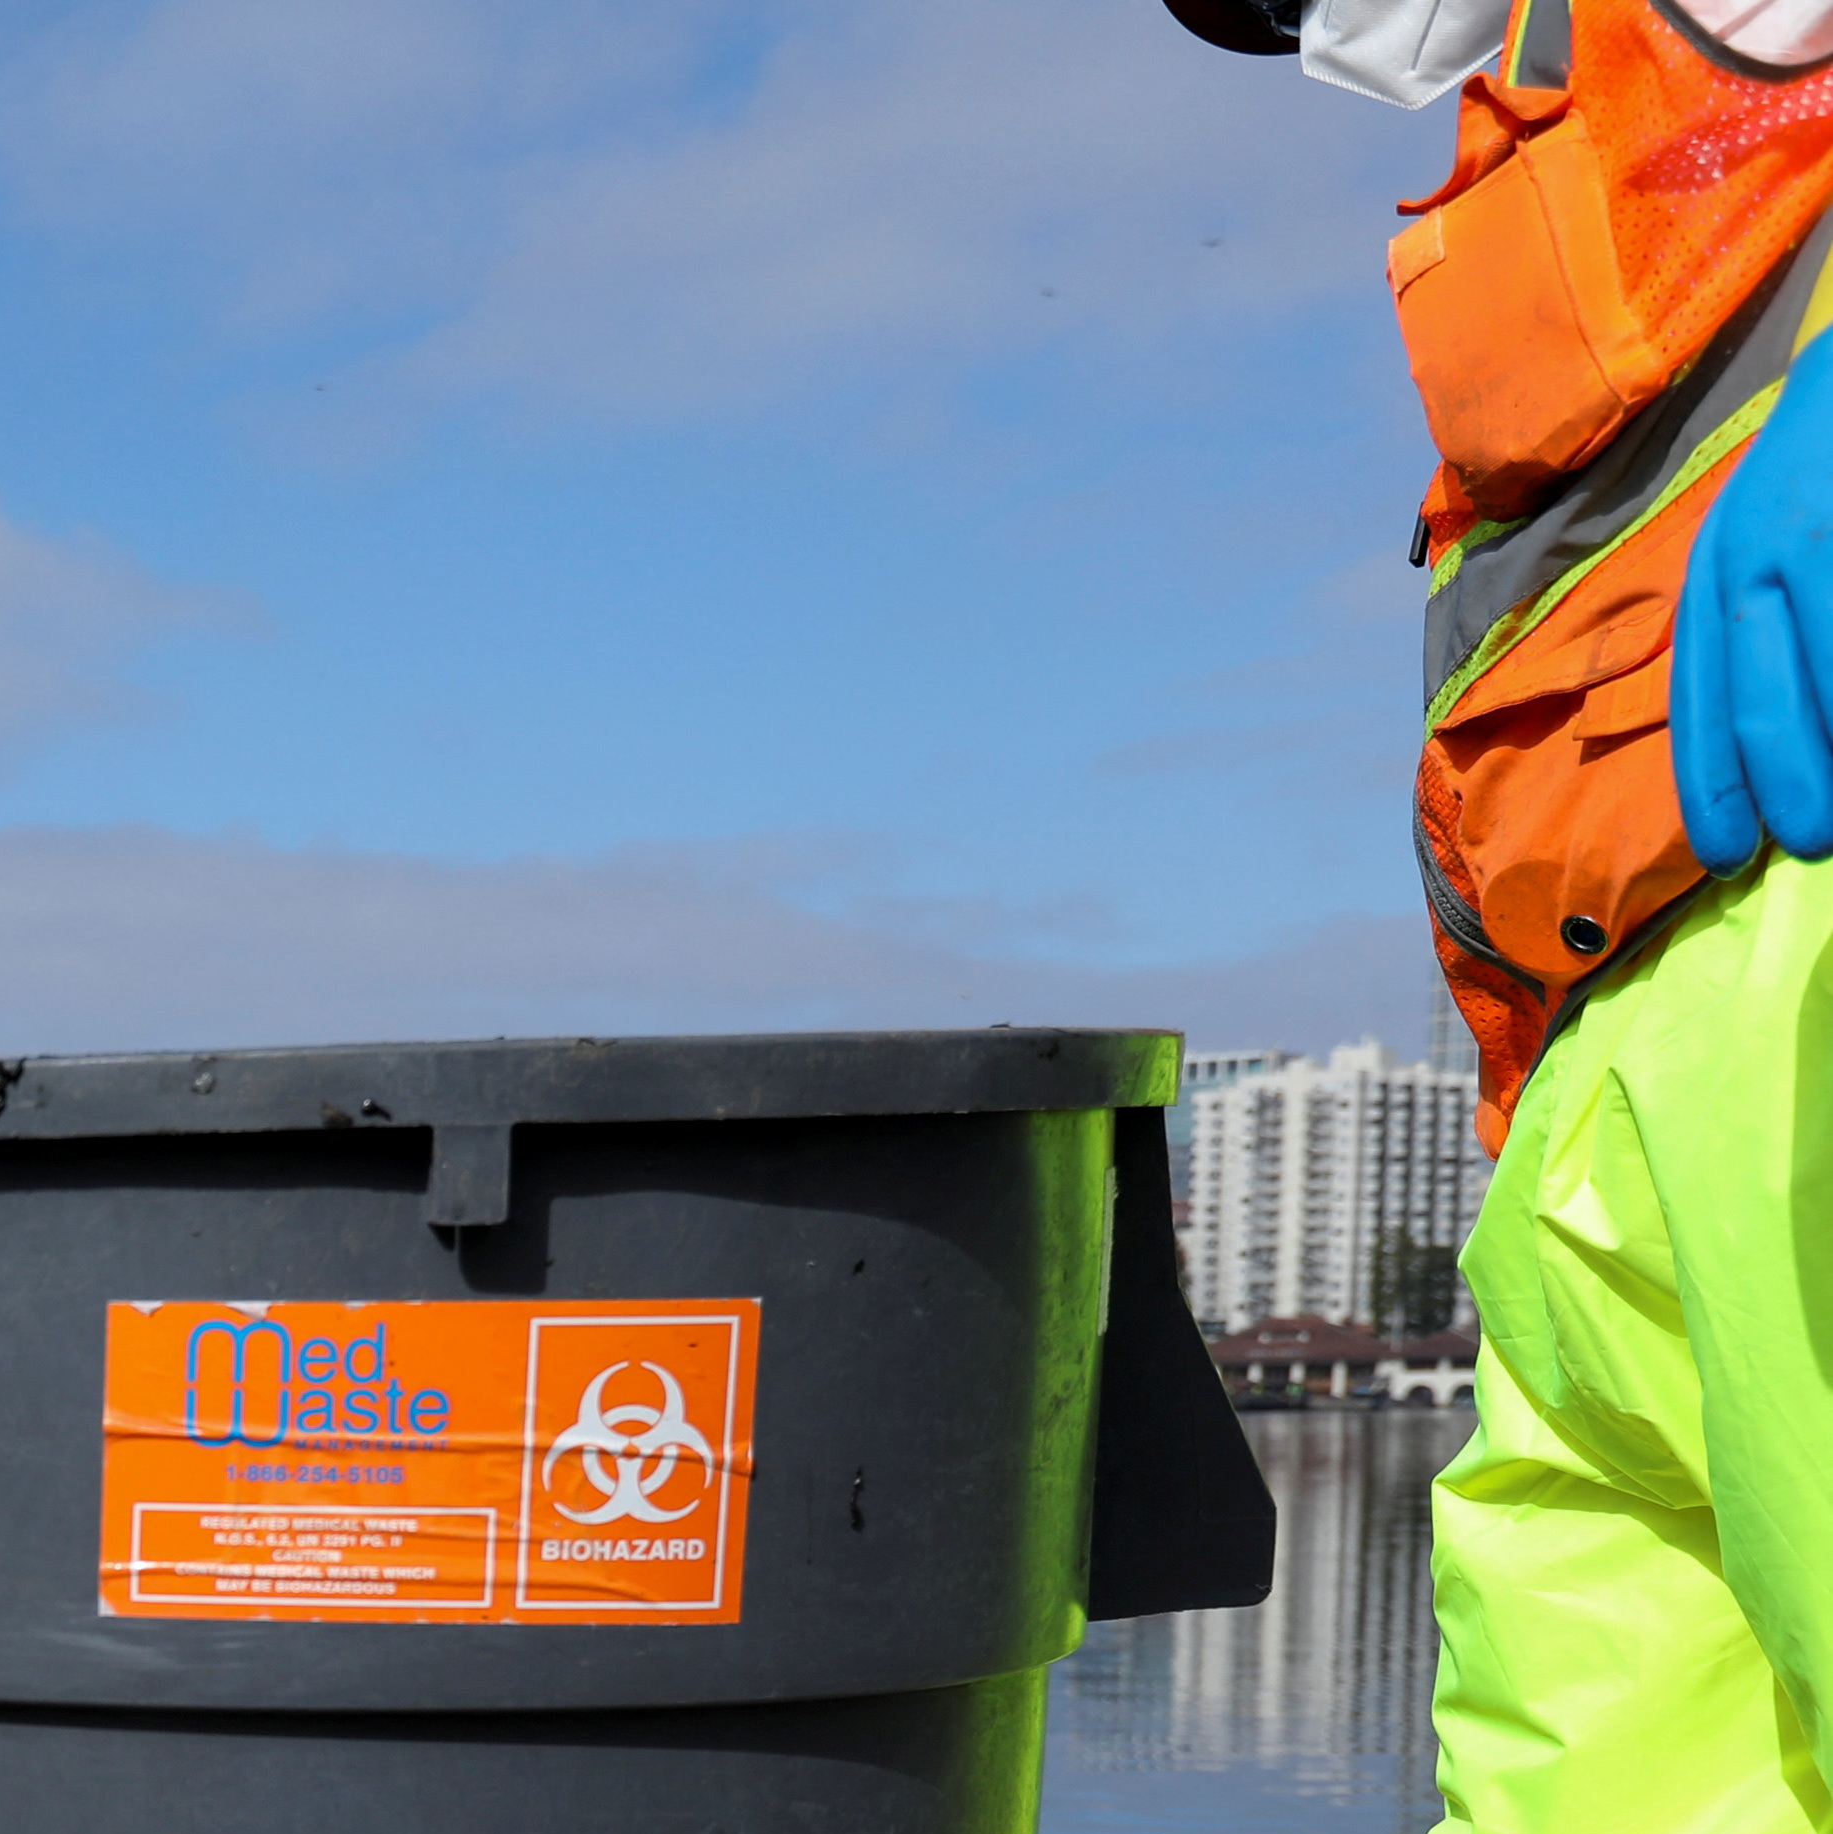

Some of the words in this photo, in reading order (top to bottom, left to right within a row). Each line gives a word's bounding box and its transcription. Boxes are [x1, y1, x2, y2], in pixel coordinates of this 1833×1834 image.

[186, 1319, 387, 1384] Med
[184, 1378, 451, 1448] Waste
[293, 1439, 450, 1452] MANAGEMENT
[226, 1464, 405, 1485] 1-866-254-5105
[199, 1515, 290, 1531] REGULATED
[292, 1517, 361, 1531] MEDICAL
[364, 1518, 419, 1533] WASTE
[296, 1534, 320, 1547] UN
[271, 1548, 343, 1563] CAUTION
[540, 1538, 706, 1562] BIOHAZARD
[174, 1561, 253, 1577] CONTAINS
[254, 1563, 324, 1578] MEDICAL
[326, 1565, 381, 1579] WASTE
[382, 1566, 437, 1580] WHICH
[215, 1578, 249, 1592] MAY
[250, 1579, 273, 1593] BE
[274, 1579, 397, 1595] BIOHAZARDOUS
